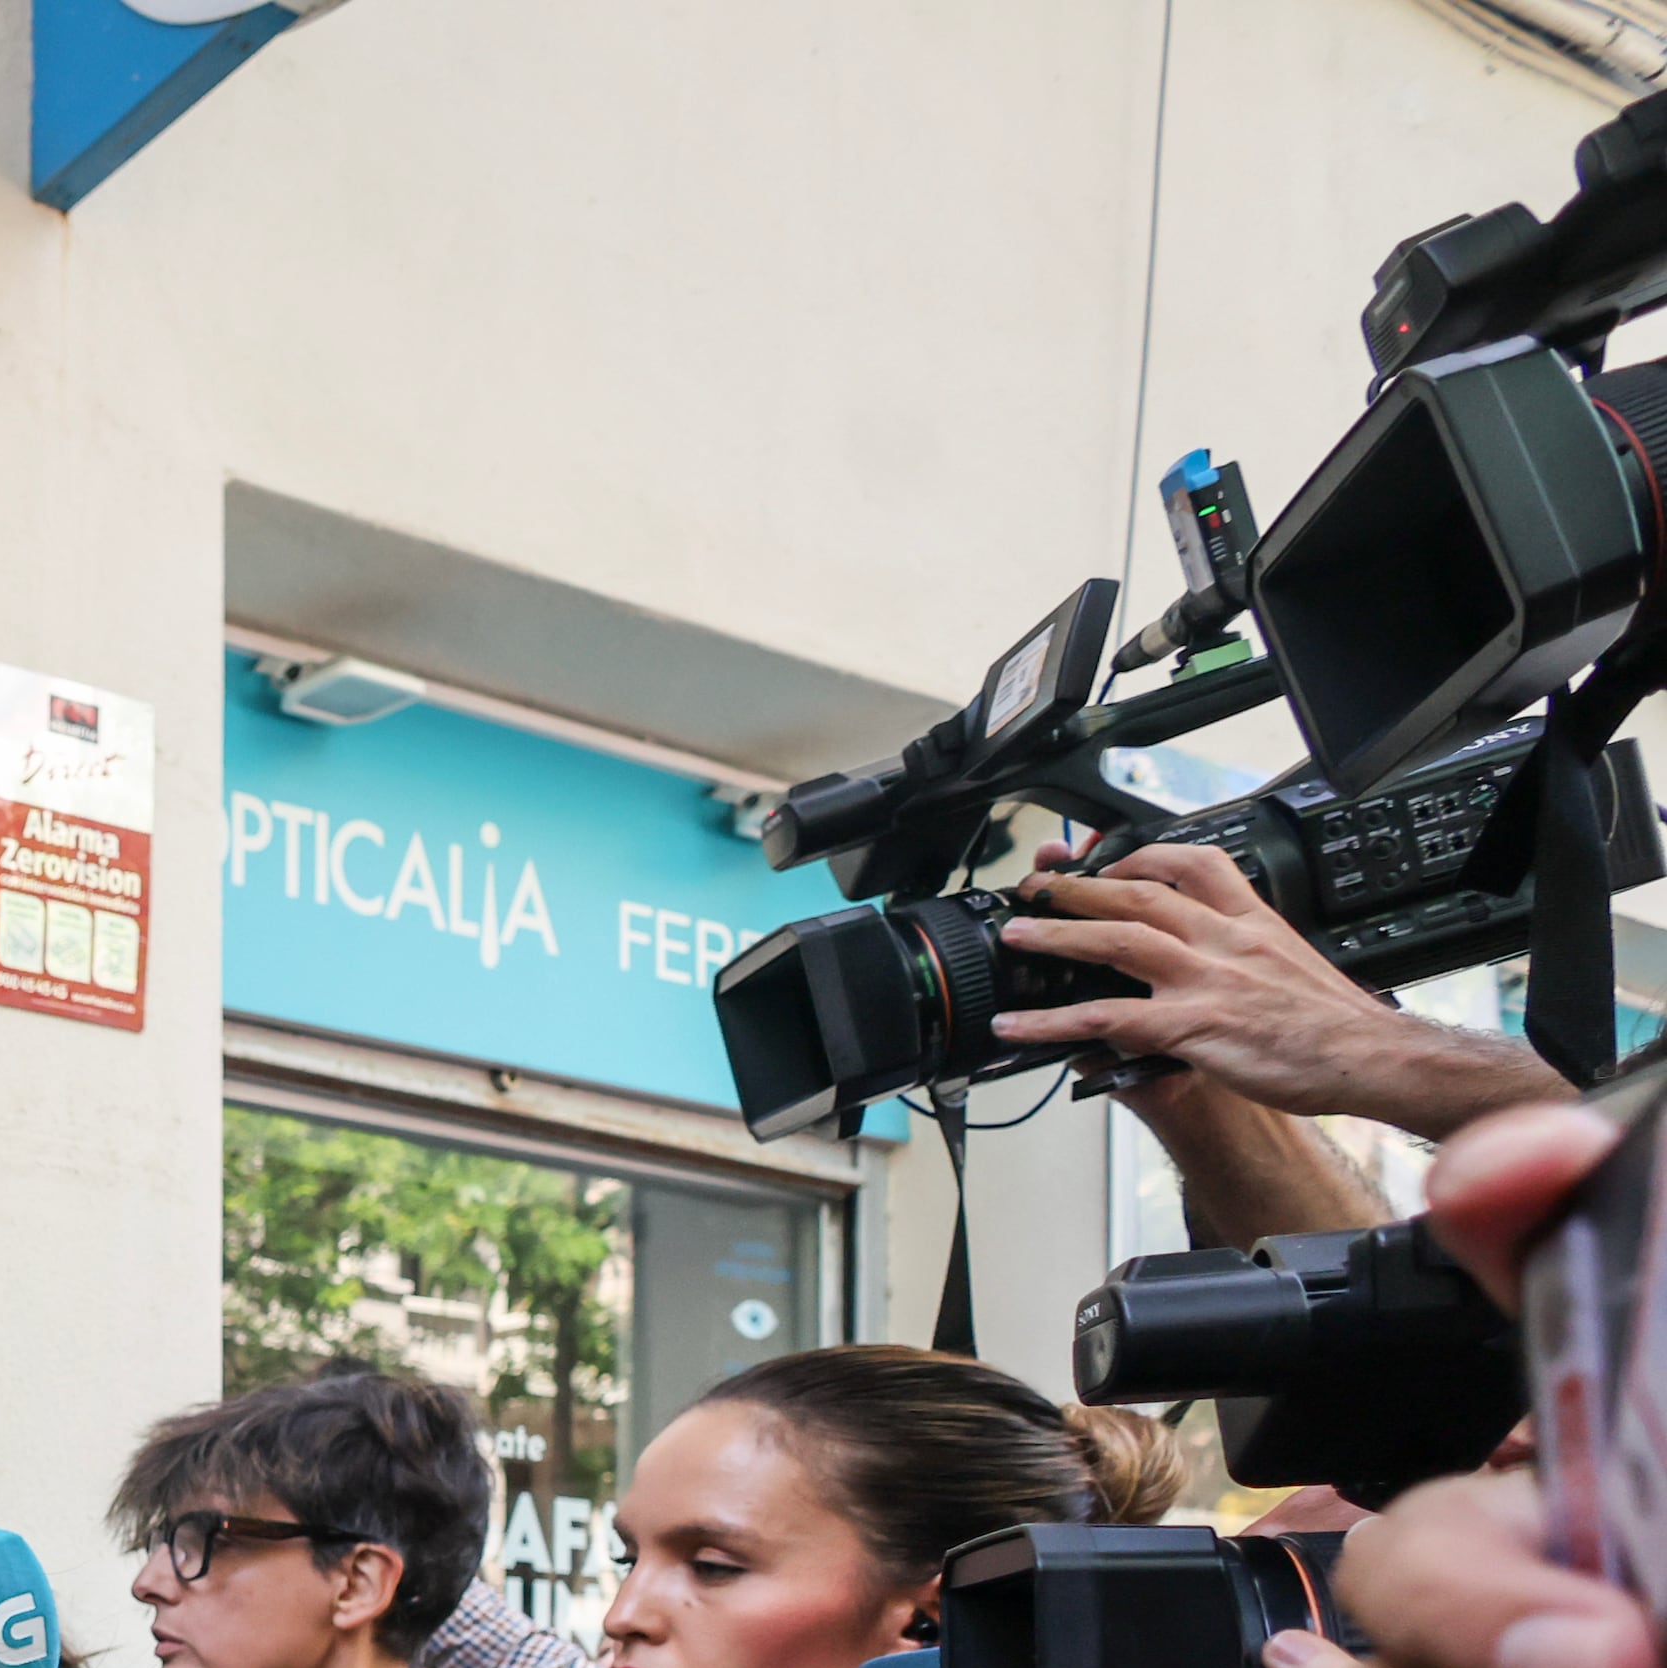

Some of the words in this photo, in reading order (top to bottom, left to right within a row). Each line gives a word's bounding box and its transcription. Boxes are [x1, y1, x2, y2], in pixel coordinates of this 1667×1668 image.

[23, 808, 120, 859] Alarma
[0, 837, 142, 898] Zerovision
[221, 789, 560, 970] PTICALiA
